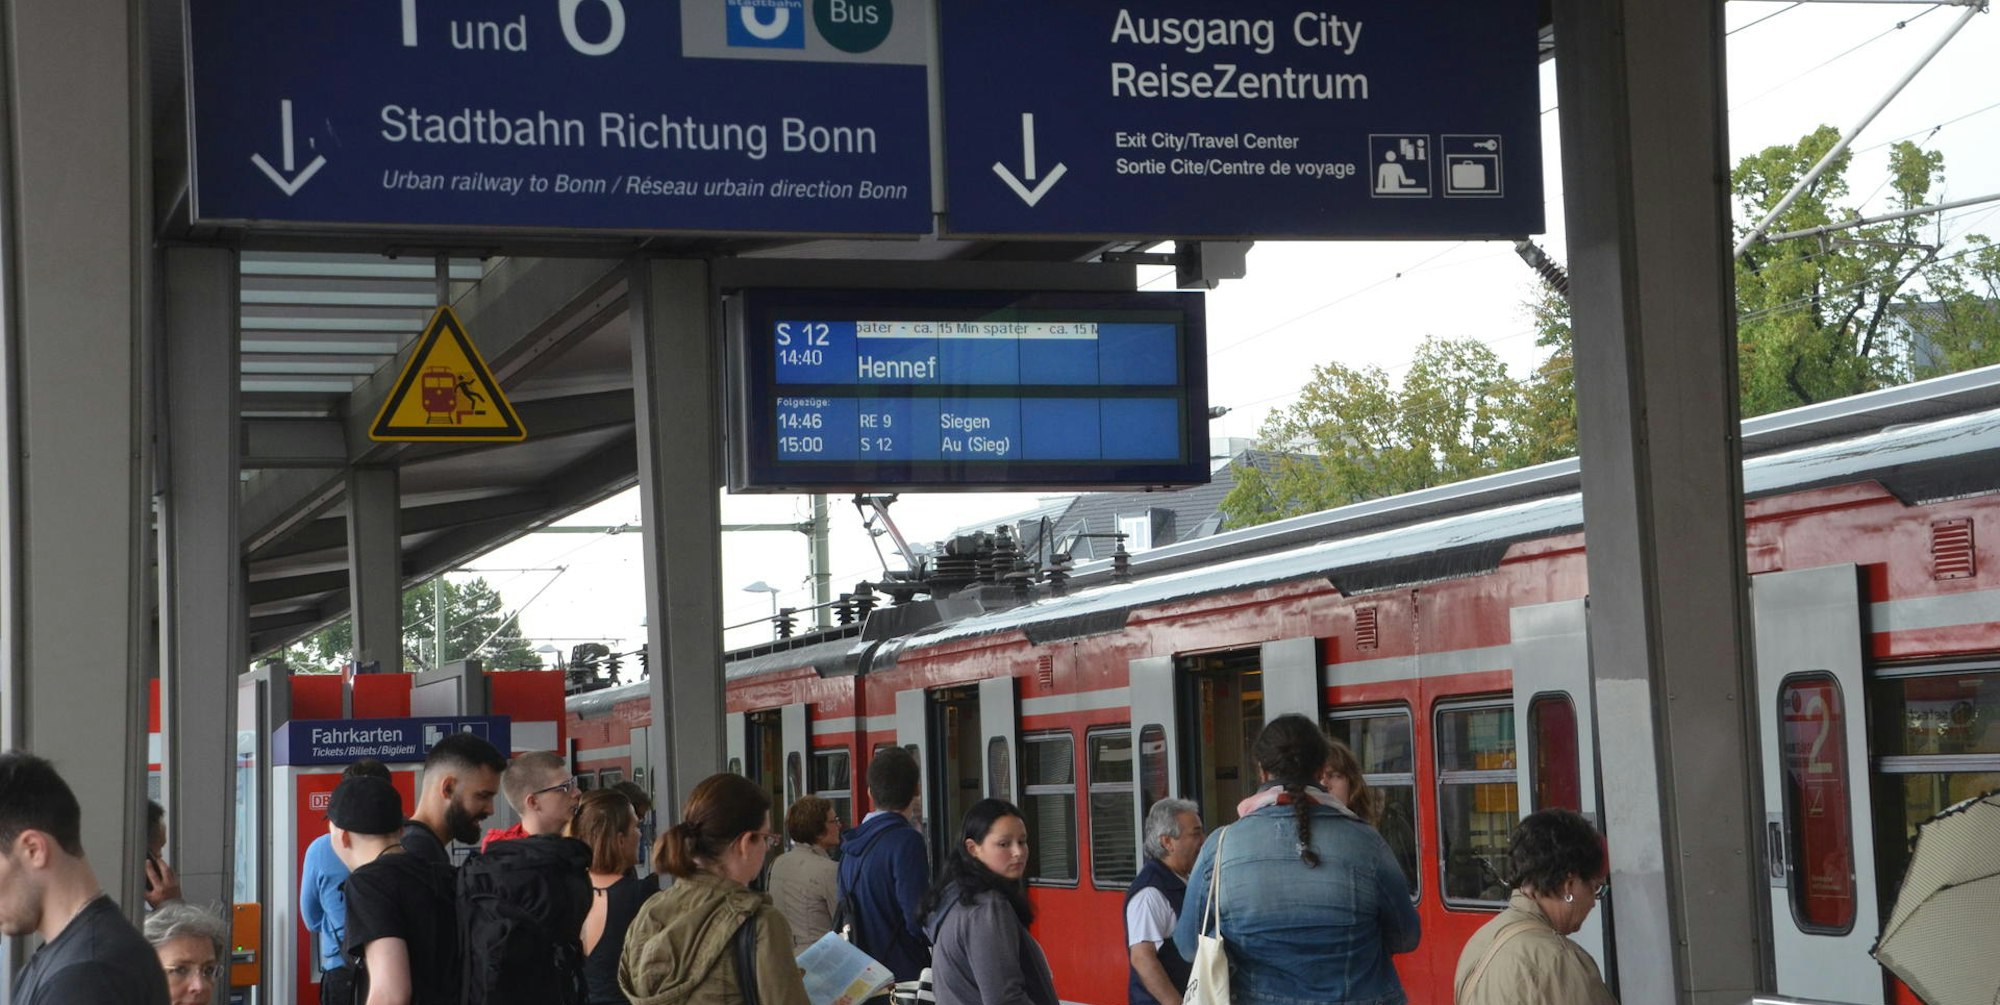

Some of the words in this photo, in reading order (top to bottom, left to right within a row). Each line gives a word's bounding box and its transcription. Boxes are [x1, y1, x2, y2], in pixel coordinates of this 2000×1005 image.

[830, 0, 879, 24] Bus
[451, 15, 527, 51] und
[1111, 9, 1275, 54] Ausgang
[1293, 11, 1362, 55] City
[1111, 62, 1369, 100] ReiseZentrum
[381, 104, 585, 147] Stadtbahn
[600, 111, 767, 160] Richtung
[782, 117, 876, 154] Bonn
[1115, 132, 1147, 148] Exit
[1151, 132, 1238, 151] City/Travel
[1243, 133, 1299, 149] Center
[1116, 158, 1166, 174] Sortie
[1170, 159, 1265, 176] Cite/Centre
[1270, 160, 1291, 175] de
[1295, 163, 1356, 179] voyage
[383, 169, 445, 190] Urban
[450, 172, 523, 196] railway
[528, 174, 549, 192] to
[554, 174, 606, 193] Bonn
[611, 175, 622, 194] /
[625, 175, 698, 196] Réseau
[703, 178, 764, 197] urbain
[770, 180, 853, 199] direction
[858, 181, 908, 200] Bonn
[777, 323, 791, 346] S
[802, 323, 830, 346] 12
[913, 324, 933, 333] ca.
[939, 323, 953, 333] 15
[956, 323, 979, 333] Min
[1049, 325, 1068, 334] ca.
[1073, 324, 1087, 334] 15
[779, 350, 823, 366] 14:40
[858, 356, 936, 378] Hennef
[779, 413, 822, 429] 14:46
[860, 414, 877, 428] RE
[883, 414, 892, 428] 9
[941, 414, 991, 432] Siegen
[779, 437, 823, 452] 15:00
[860, 438, 870, 451] S
[876, 438, 893, 451] 12
[942, 437, 962, 452] Au
[968, 437, 1010, 455] (Sieg)
[312, 728, 402, 744] Fahrkarten
[1806, 695, 1833, 774] 2
[312, 745, 416, 757] Tickets/Billets/Biglietti
